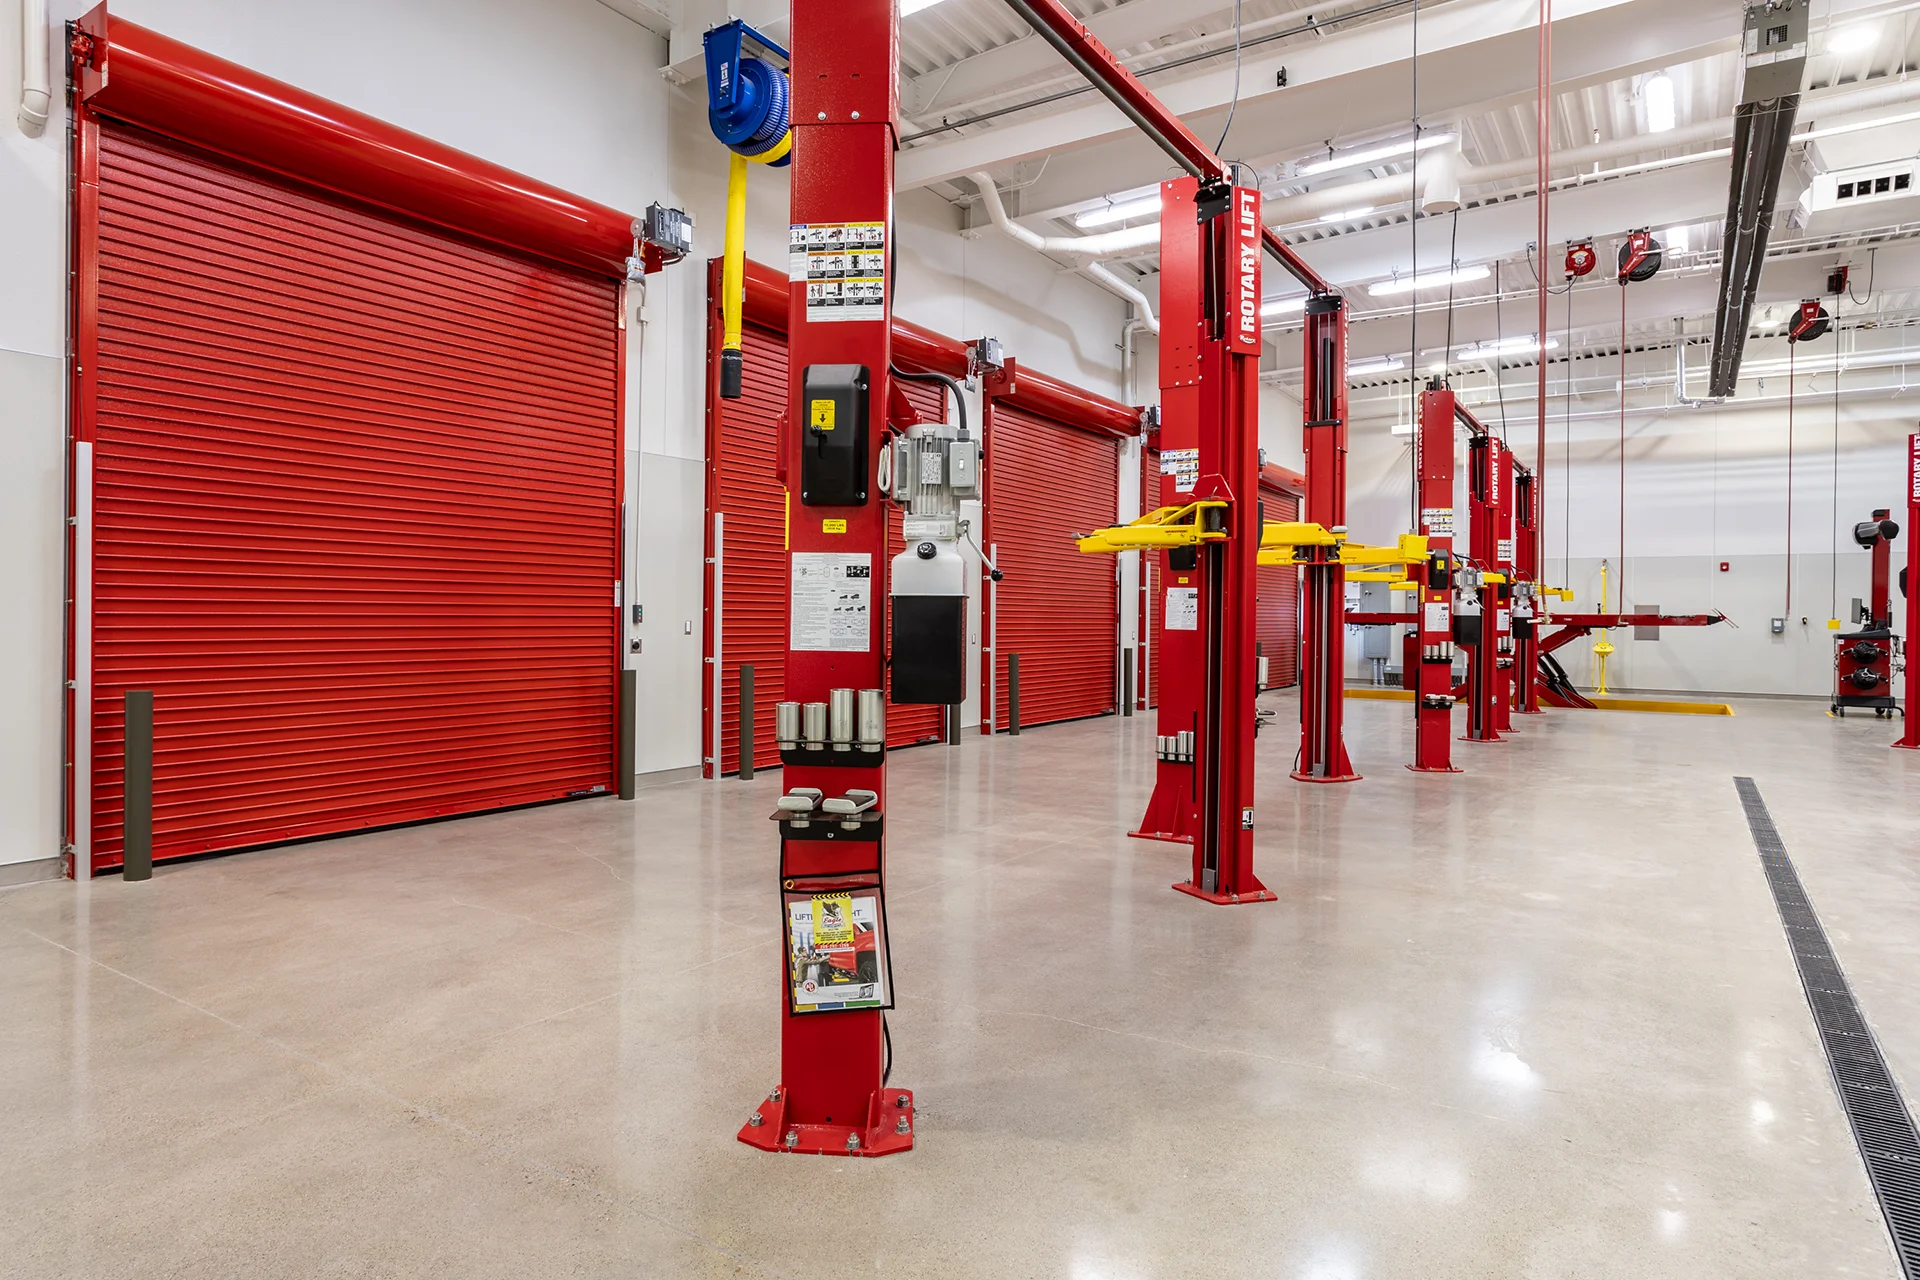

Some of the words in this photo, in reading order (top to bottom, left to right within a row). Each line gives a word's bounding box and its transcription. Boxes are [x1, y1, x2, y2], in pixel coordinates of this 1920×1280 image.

[1240, 190, 1255, 238] LIFT
[1240, 242, 1255, 333] ROTARY
[795, 913, 813, 921] LIFTI
